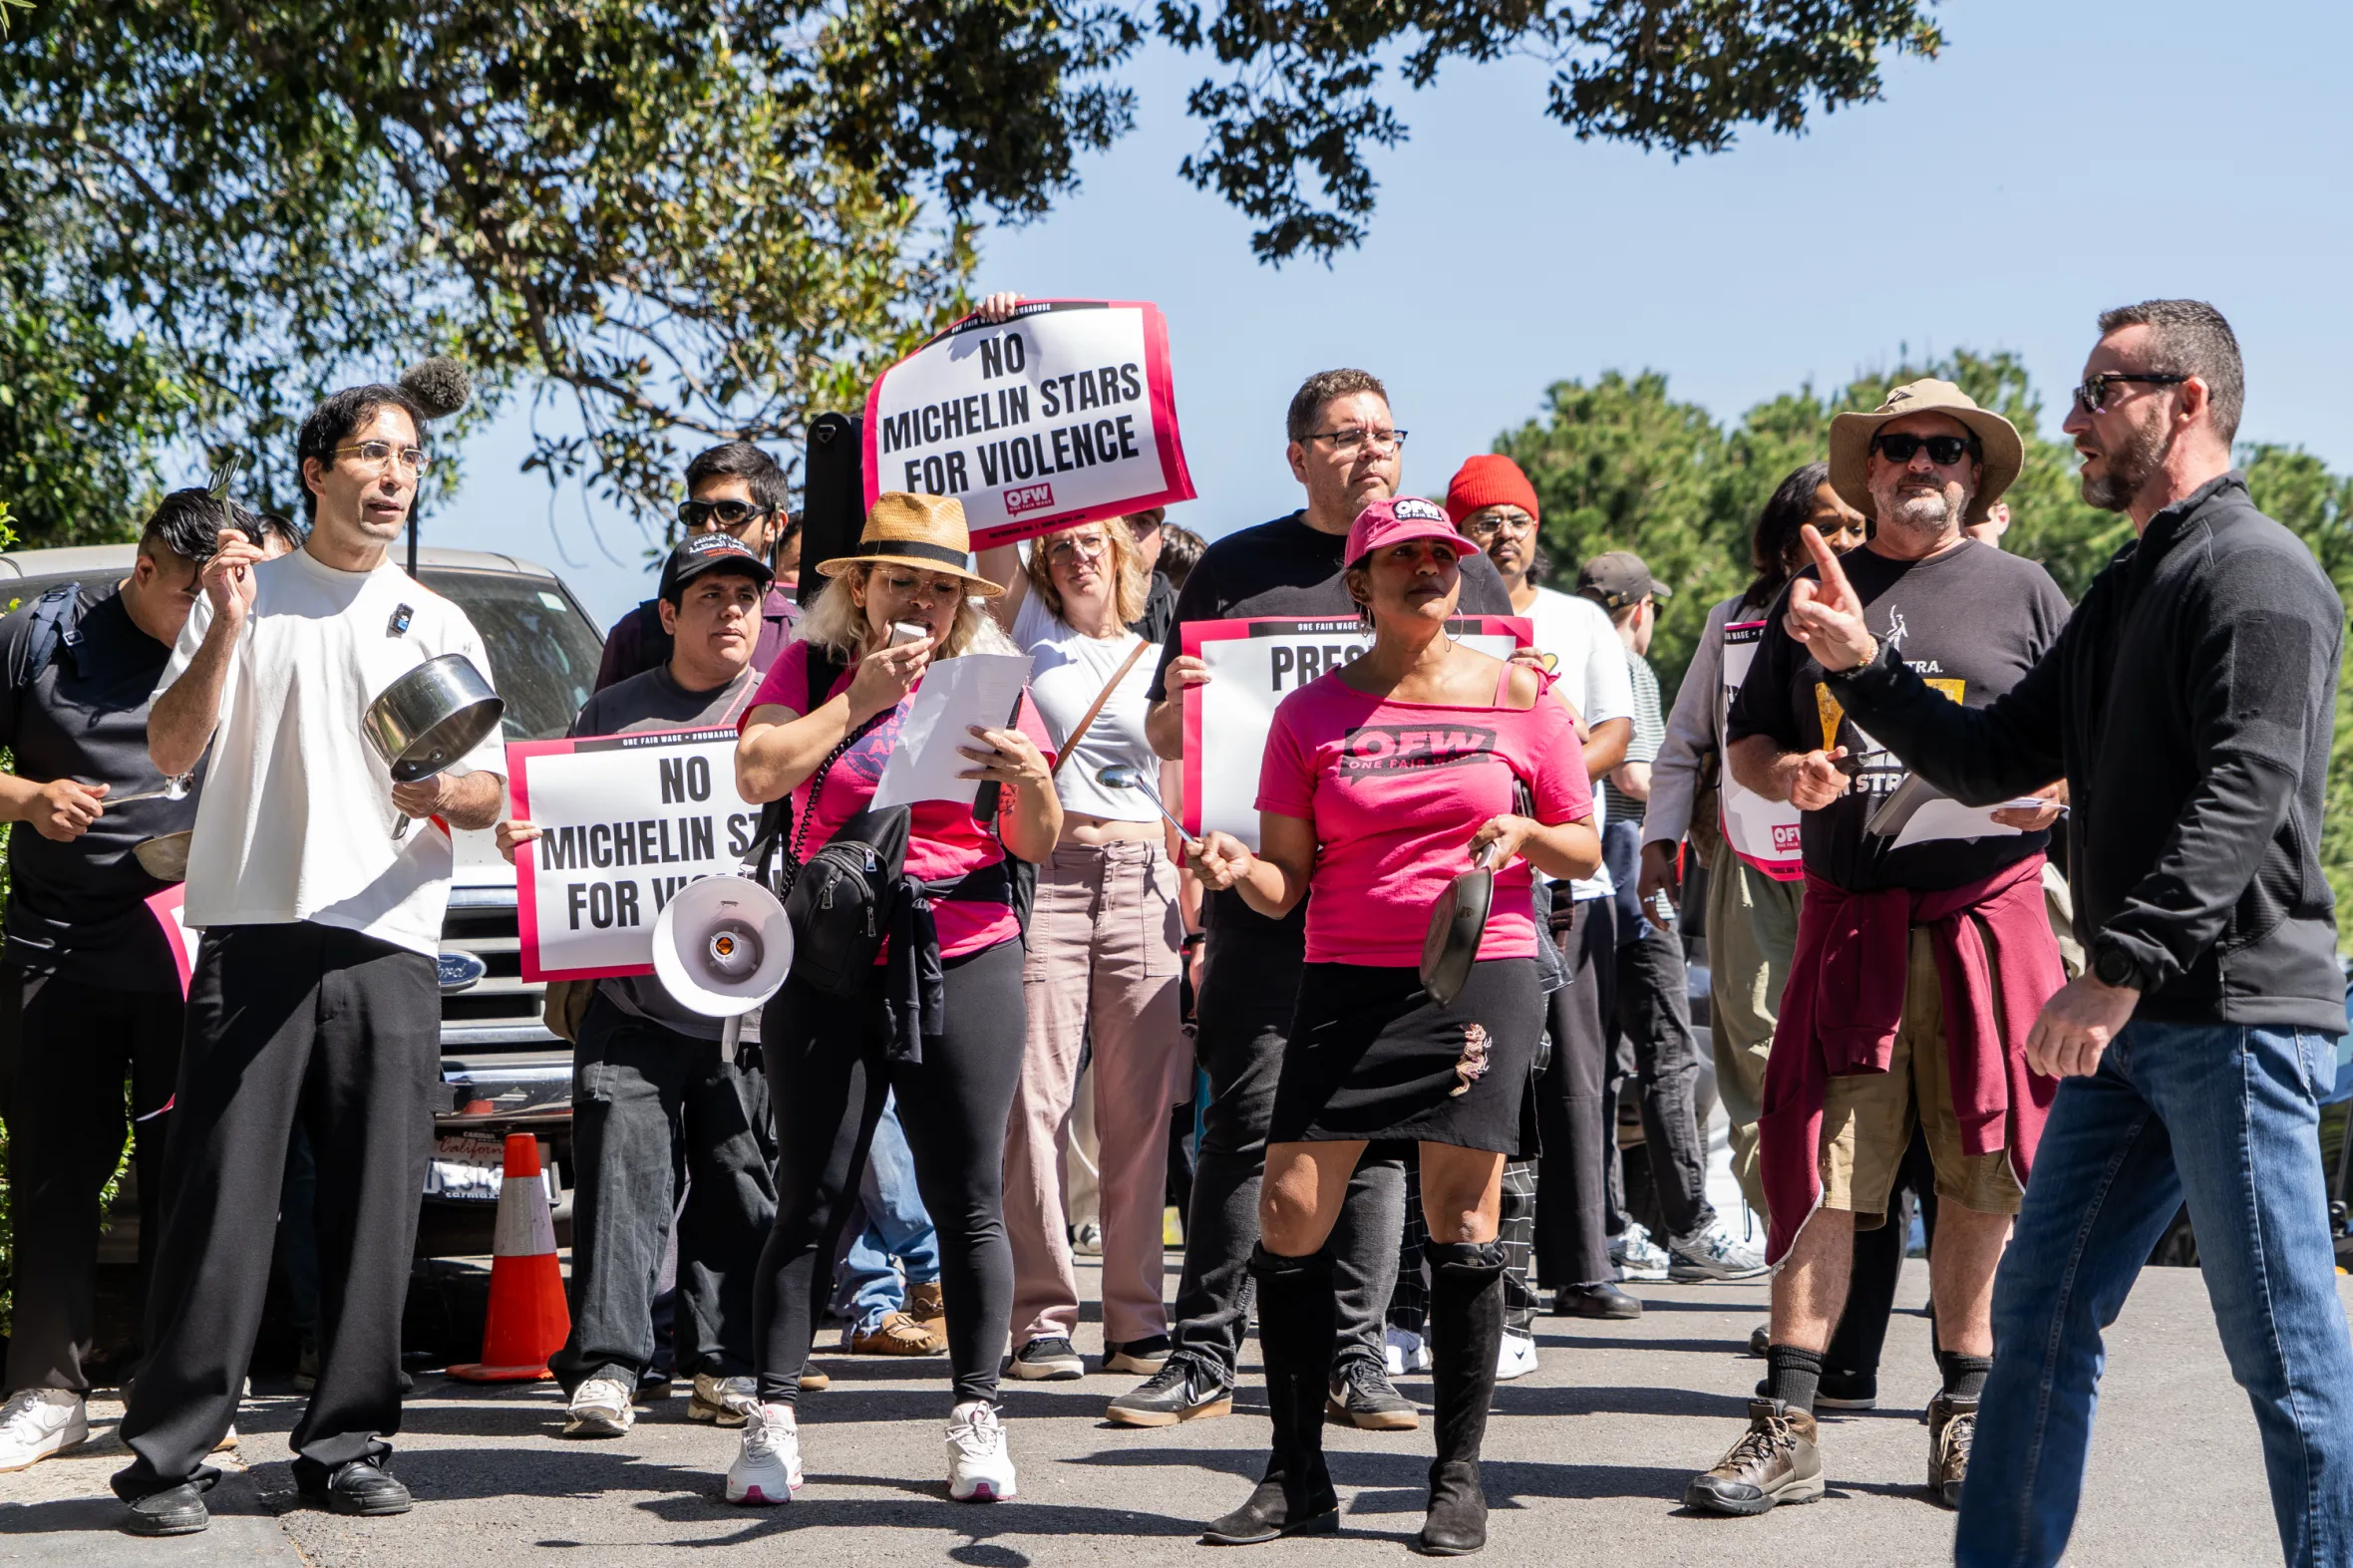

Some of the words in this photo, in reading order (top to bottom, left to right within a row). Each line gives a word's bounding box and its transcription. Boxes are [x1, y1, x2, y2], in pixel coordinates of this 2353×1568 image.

[980, 333, 1026, 380] NO
[883, 385, 1030, 455] MICHELIN
[1040, 363, 1142, 418] STARS
[904, 451, 969, 495] FOR
[976, 415, 1140, 487] VIOLENCE
[1006, 485, 1049, 506] OFW
[1395, 499, 1439, 516] OFW
[1316, 622, 1334, 631] FAIR
[1270, 645, 1369, 692] PRE
[623, 738, 638, 747] ONE
[641, 736, 659, 746] FAIR
[661, 735, 682, 744] WAGE
[693, 729, 739, 741] #NOMAABUS
[1352, 730, 1488, 762] OFW
[659, 756, 712, 804] NO
[1349, 760, 1382, 770] ONE
[1389, 758, 1426, 770] FAIR
[1855, 773, 1910, 792] STR
[541, 815, 715, 870] MICHELIN
[567, 880, 640, 930] FOR
[440, 1136, 504, 1159] Californ
